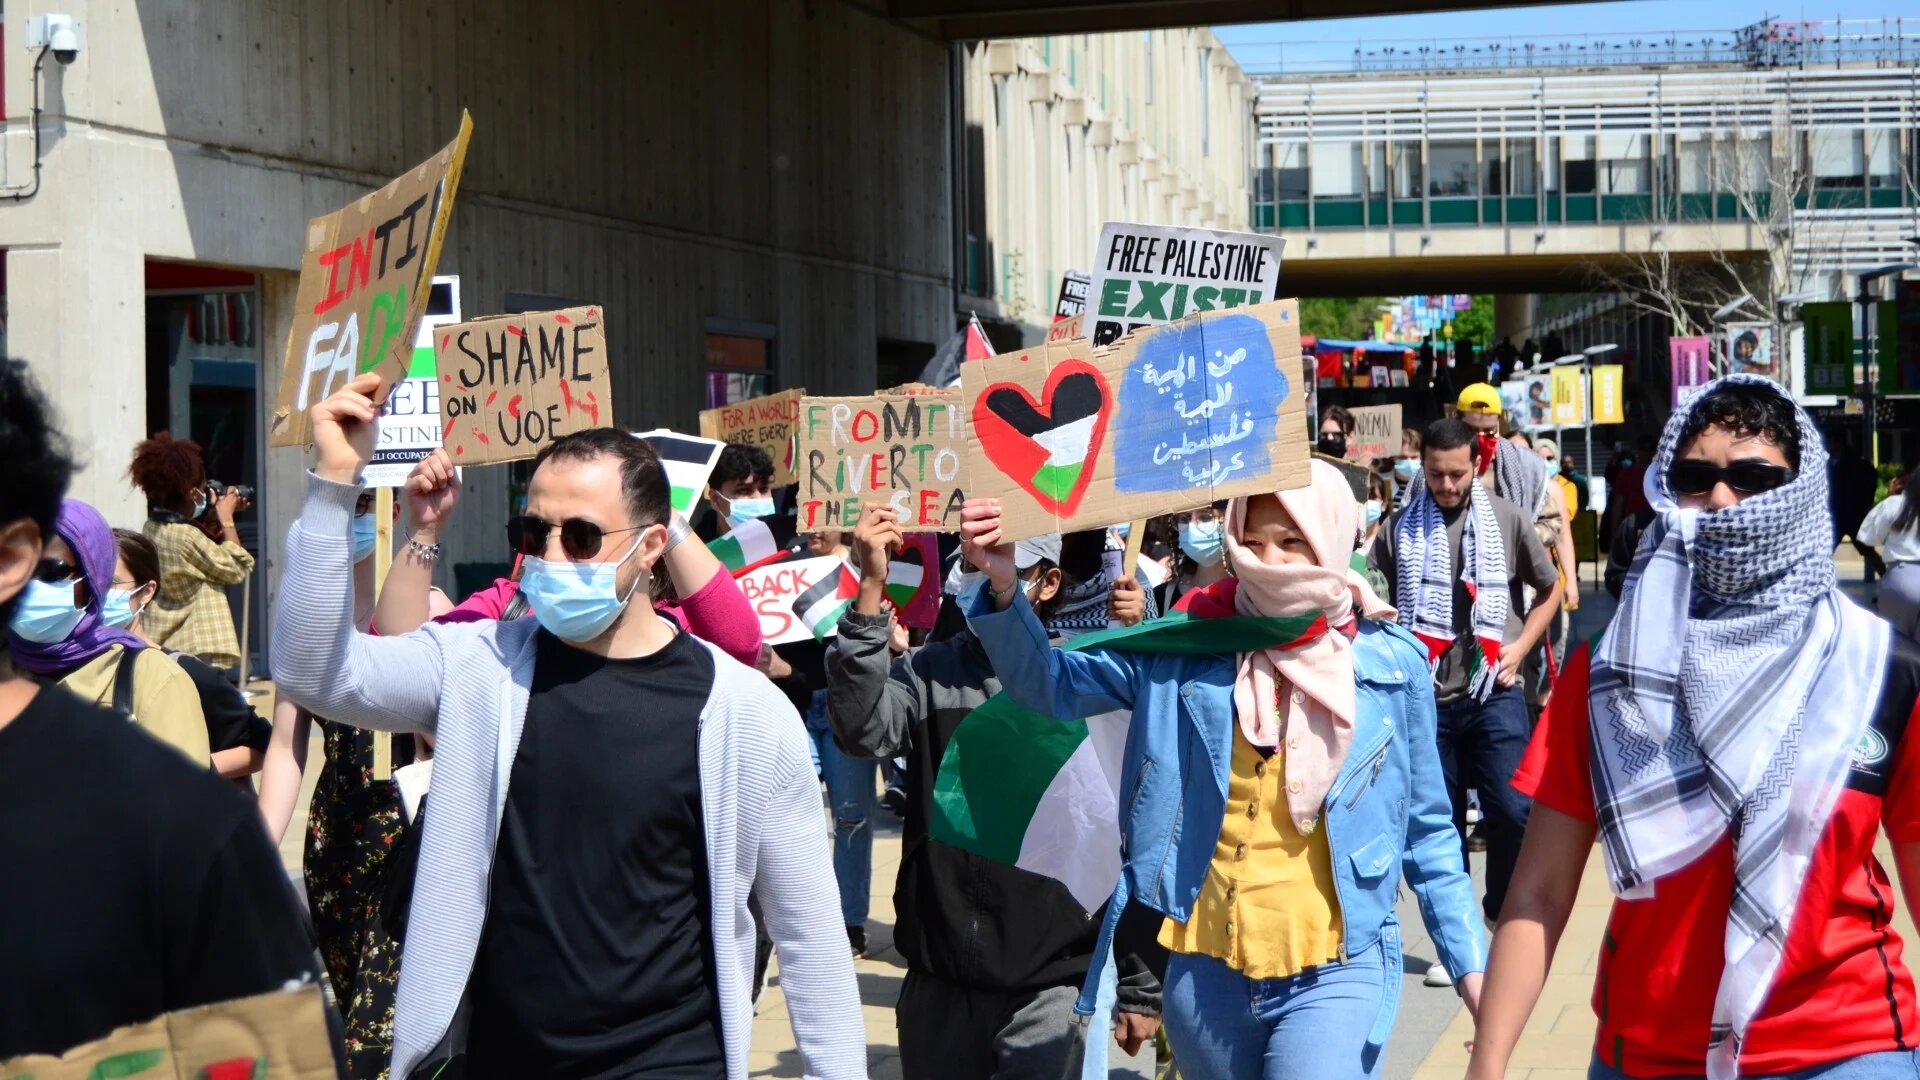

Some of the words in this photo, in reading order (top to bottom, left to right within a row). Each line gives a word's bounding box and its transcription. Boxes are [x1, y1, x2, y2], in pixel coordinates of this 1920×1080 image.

[314, 192, 428, 315] INTI
[1107, 234, 1160, 274] FREE
[1161, 238, 1270, 283] PALESTINE
[1065, 280, 1089, 298] FRE
[458, 323, 597, 388] SHAME
[1207, 348, 1247, 378] من
[390, 380, 441, 416] EE
[447, 395, 477, 417] ON
[721, 408, 745, 430] FOR
[748, 405, 756, 424] A
[757, 399, 800, 422] WORLD
[381, 425, 443, 443] STINE
[498, 404, 567, 446] UOE
[721, 428, 754, 444] WHERE
[759, 422, 789, 443] EVERY
[808, 397, 921, 446] FROM
[925, 404, 966, 441] TH
[1152, 410, 1254, 465] فلسطين
[1353, 411, 1392, 437] NDEMN
[910, 444, 959, 482] TO
[803, 496, 861, 529] THE
[890, 488, 965, 526] SEA
[742, 567, 813, 599] BACK
